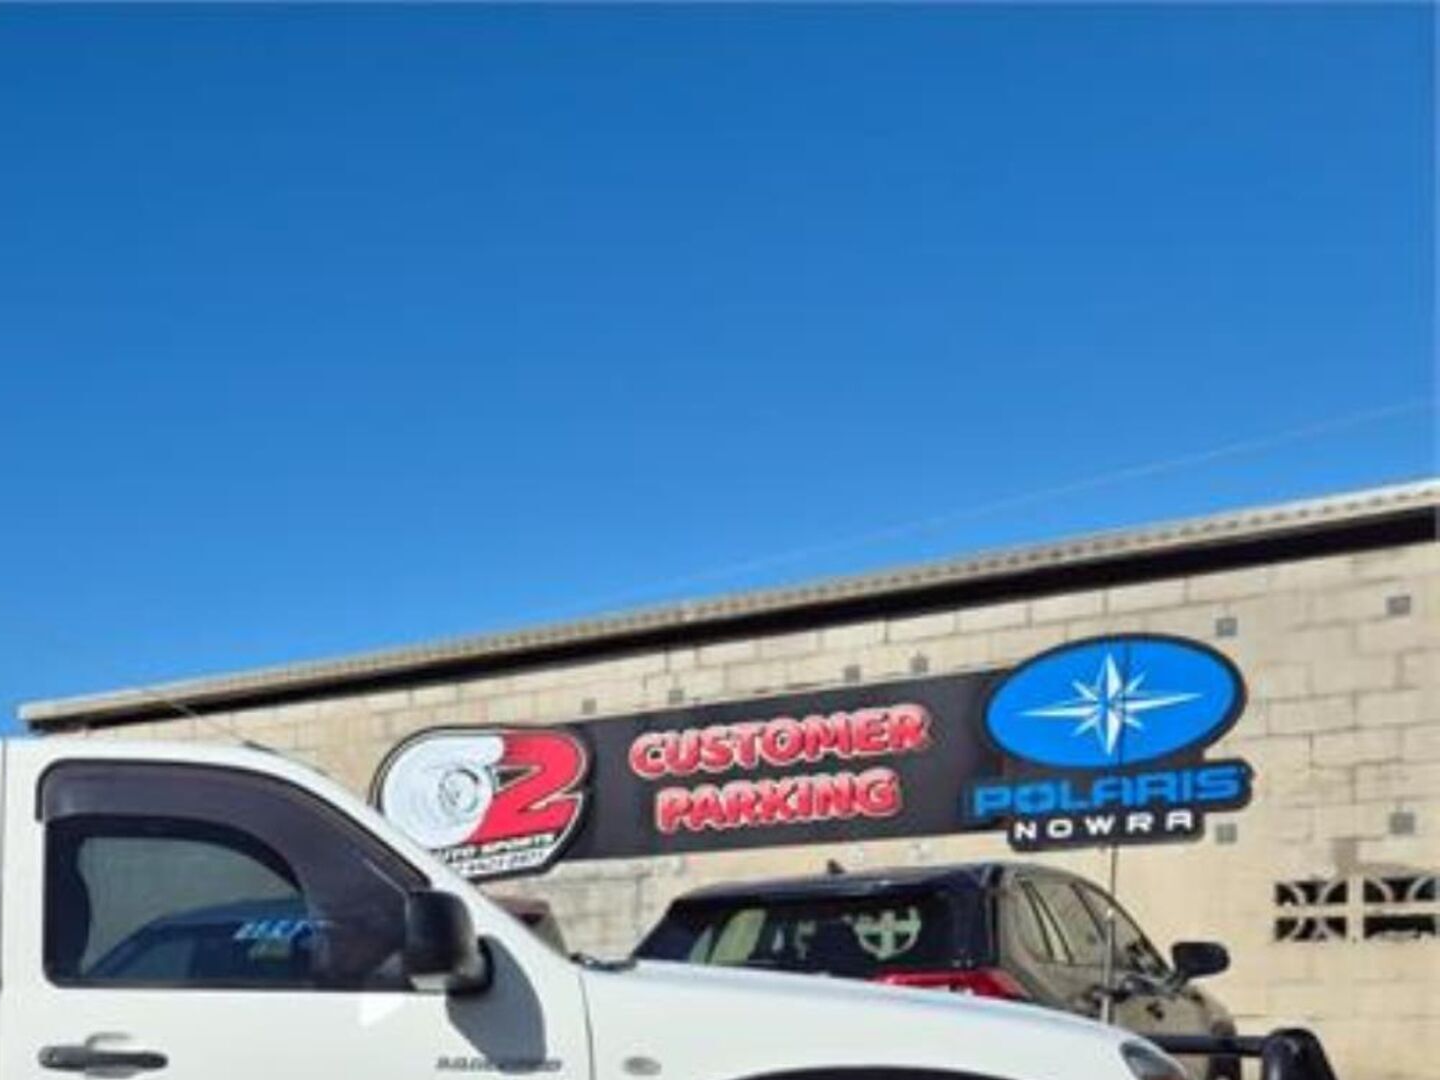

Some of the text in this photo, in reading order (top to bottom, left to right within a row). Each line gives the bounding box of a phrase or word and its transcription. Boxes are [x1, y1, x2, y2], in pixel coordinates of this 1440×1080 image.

[629, 704, 931, 779] CUSTOMER
[656, 767, 900, 833] PARKING
[974, 765, 1242, 816] POLARIS
[1014, 810, 1194, 840] NOWRA
